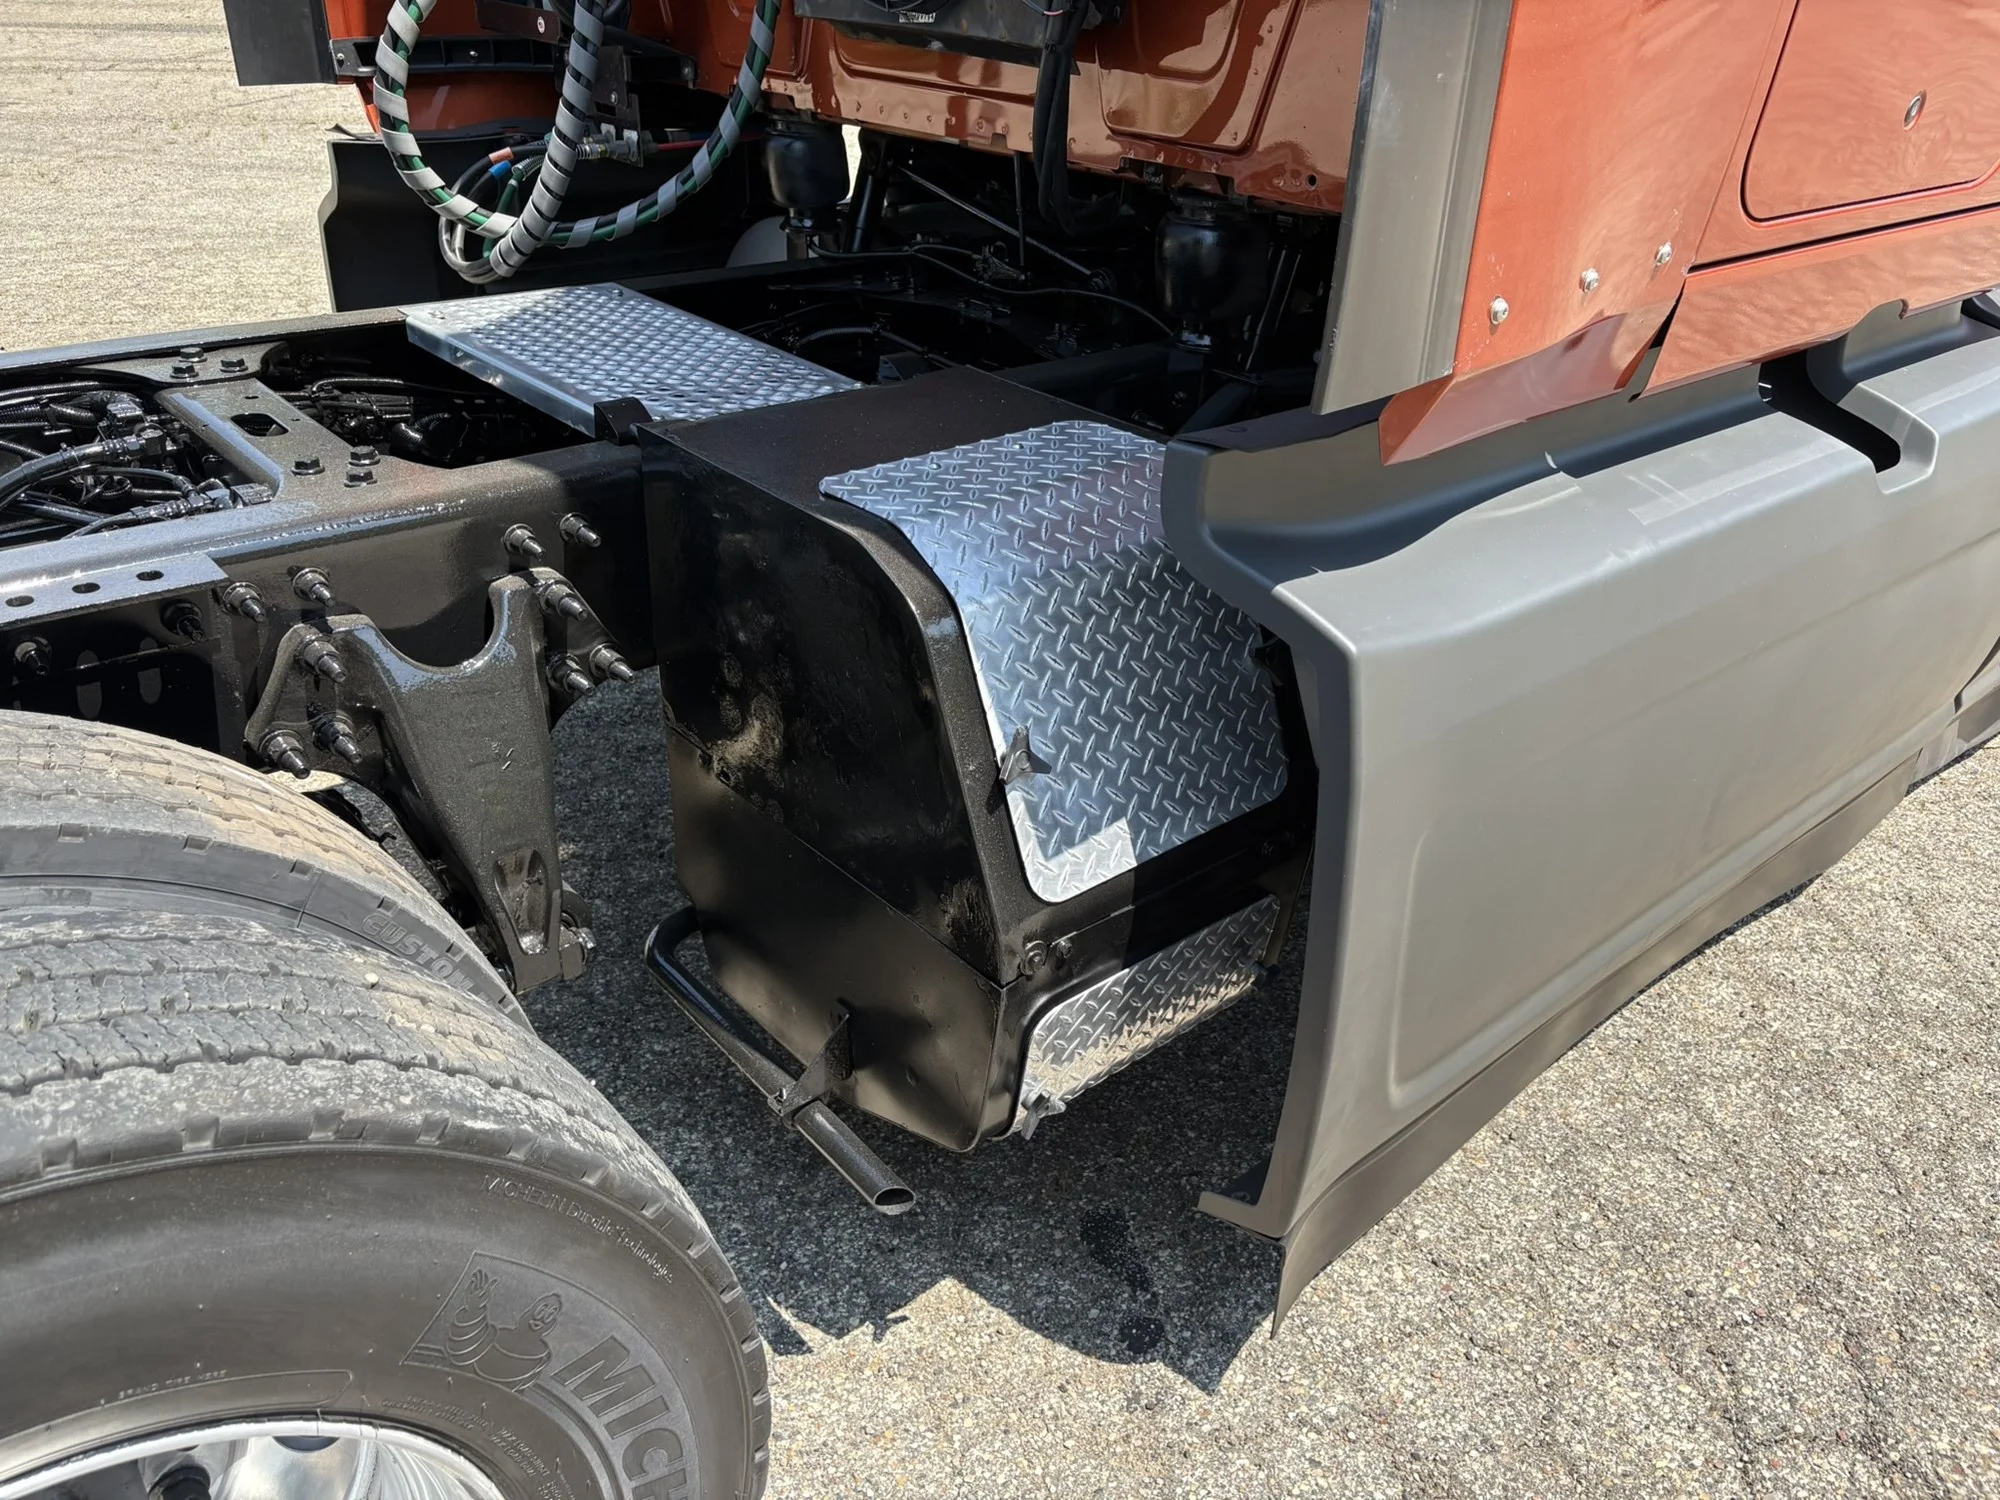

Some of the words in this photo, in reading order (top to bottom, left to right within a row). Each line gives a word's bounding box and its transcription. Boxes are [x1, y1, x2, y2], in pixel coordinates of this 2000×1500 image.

[362, 913, 475, 992] CUSTOM
[481, 1174, 566, 1213] MICHELIN
[566, 1201, 613, 1236] Durable
[615, 1224, 675, 1285] Technologies
